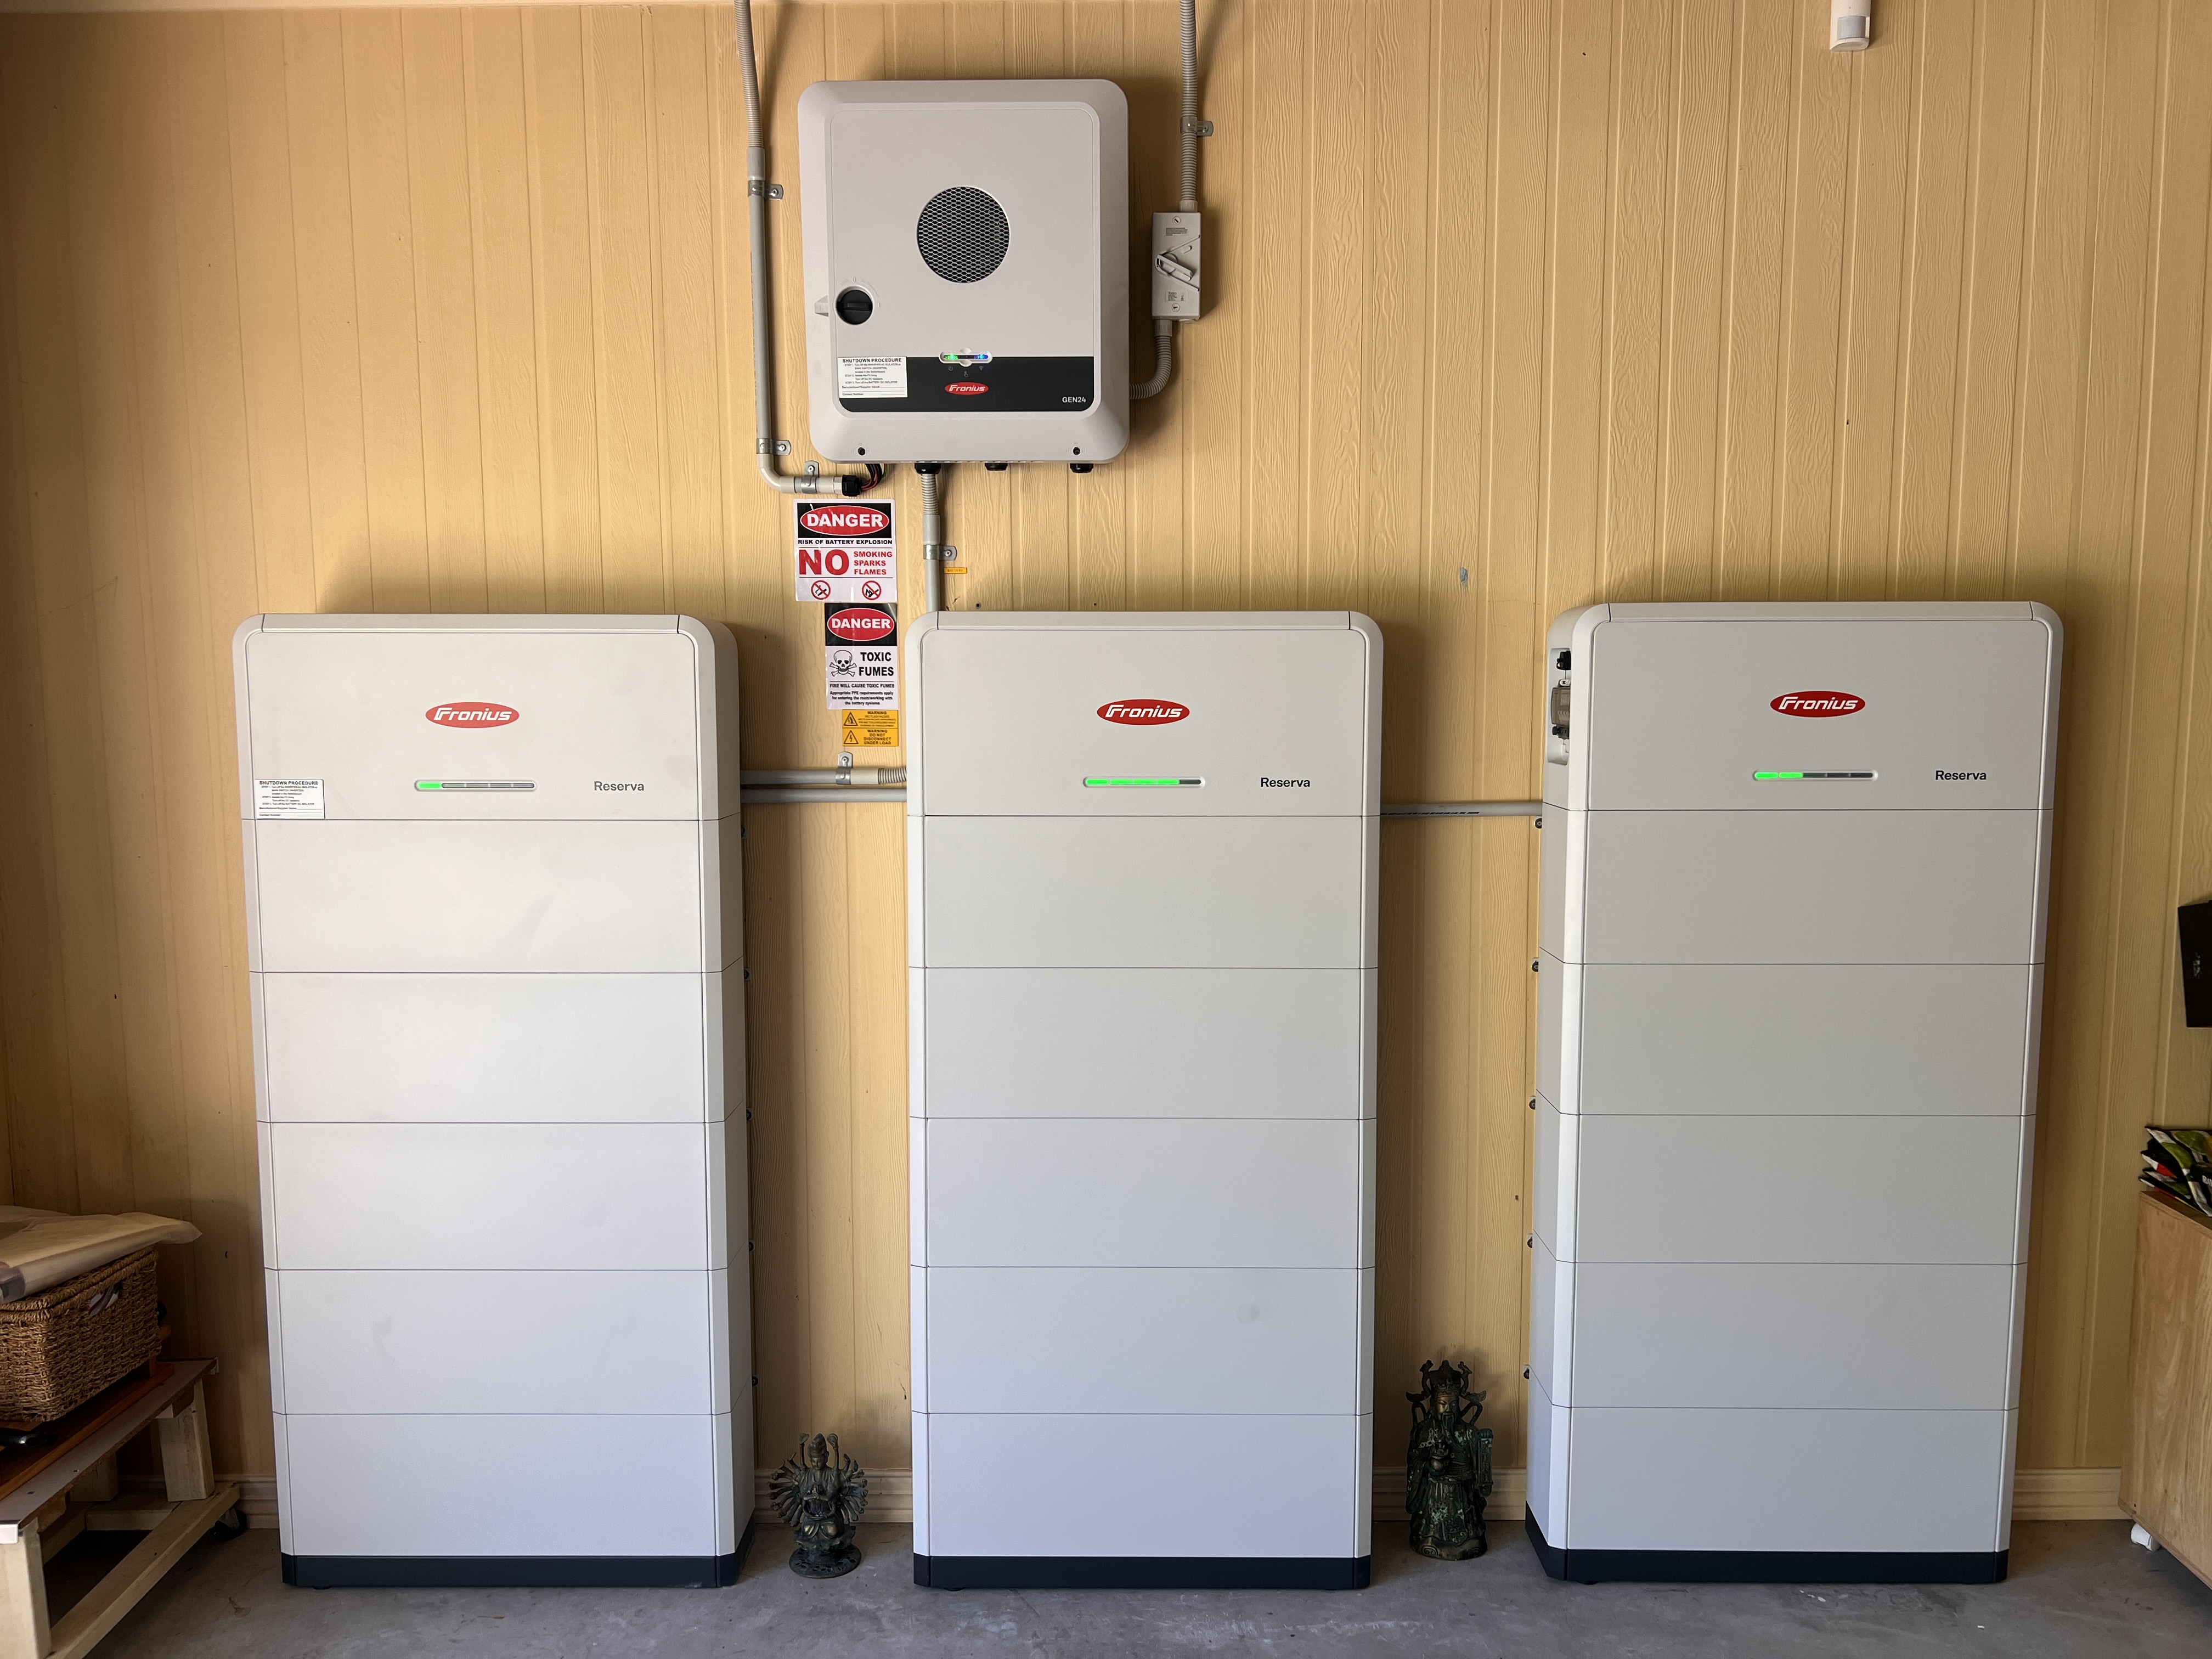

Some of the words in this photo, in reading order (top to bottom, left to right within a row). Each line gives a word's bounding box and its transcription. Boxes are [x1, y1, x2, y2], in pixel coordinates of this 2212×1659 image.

[806, 514, 883, 527] DANGER
[798, 549, 849, 575] NO
[832, 618, 891, 629] DANGER
[860, 652, 891, 662] TOXIC
[859, 667, 894, 676] FUMES
[1779, 696, 1858, 710] Fronius
[433, 707, 512, 721] Fronius
[1105, 704, 1183, 718] Fronius
[1936, 770, 1987, 781] Reserva
[594, 781, 645, 792] Reserva
[1261, 777, 1311, 788] Reserva
